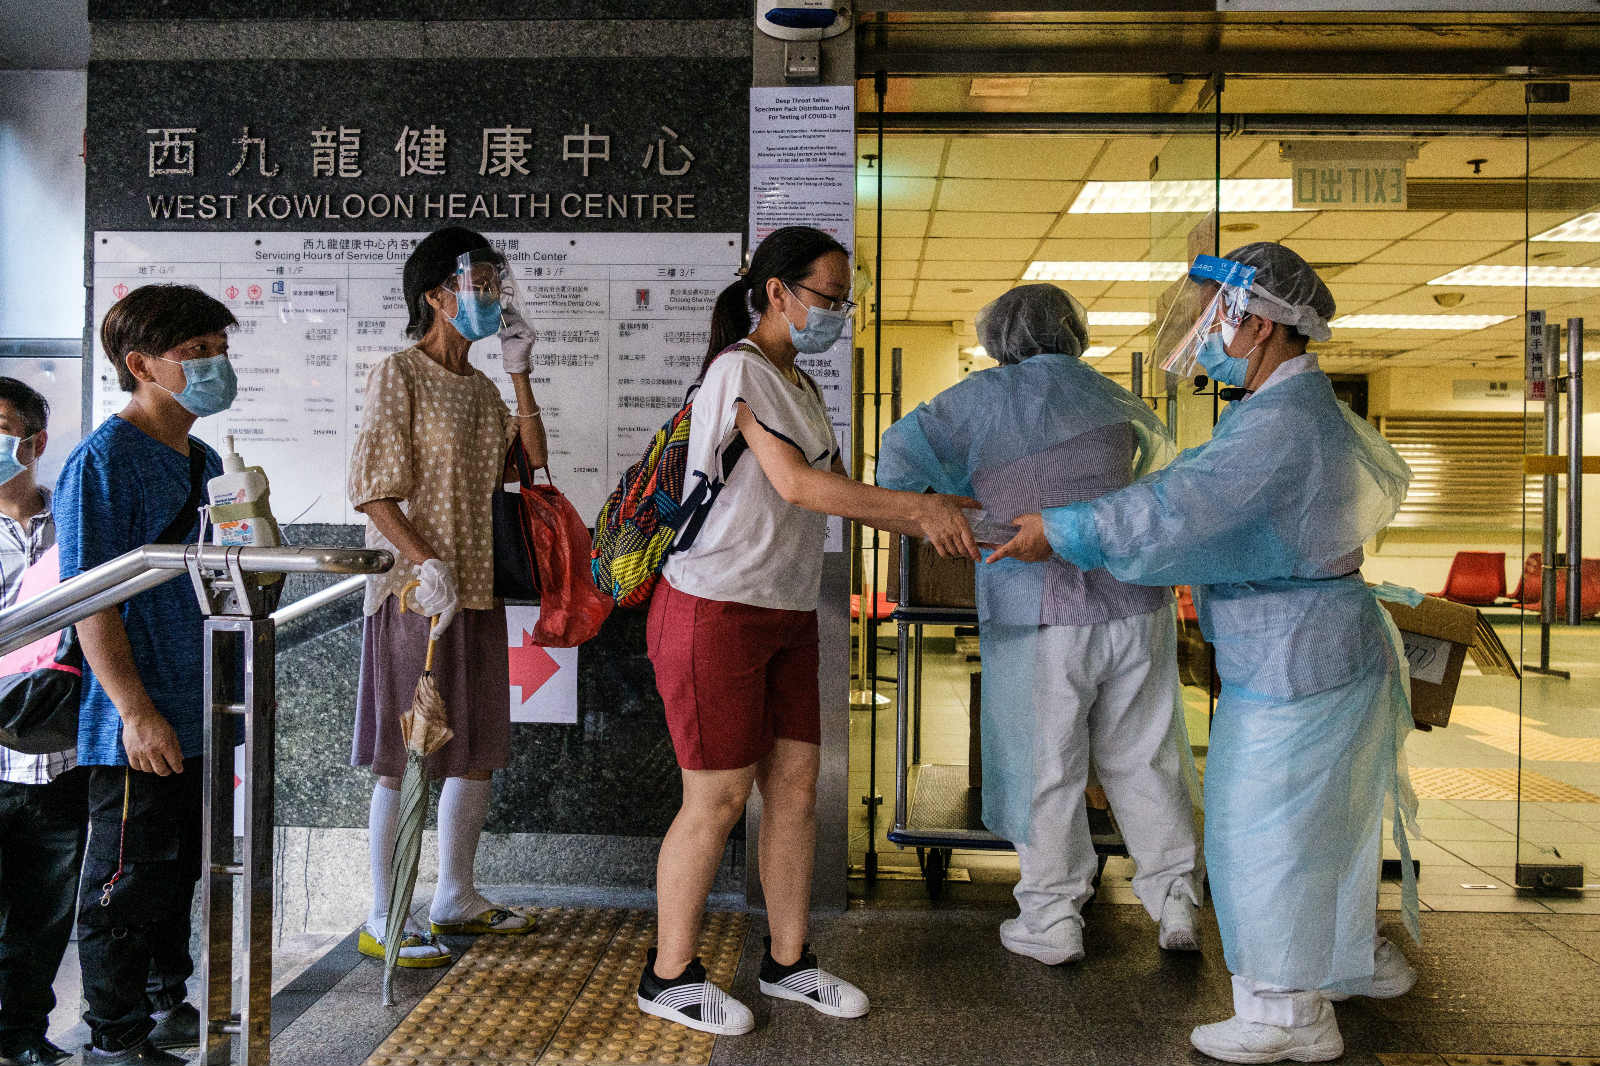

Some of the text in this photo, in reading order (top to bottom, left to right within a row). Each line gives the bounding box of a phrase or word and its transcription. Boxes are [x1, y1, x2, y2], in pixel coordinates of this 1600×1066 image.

[146, 123, 695, 178] 西九龍健康中心
[146, 193, 696, 219] WEST KOWLOON HEALTH CENTRE
[255, 250, 301, 262] Servicing
[303, 250, 333, 261] Hours
[334, 250, 344, 261] of
[346, 250, 384, 261] Service
[506, 252, 531, 262] ealth
[533, 252, 568, 262] Center
[656, 268, 676, 277] 三樓
